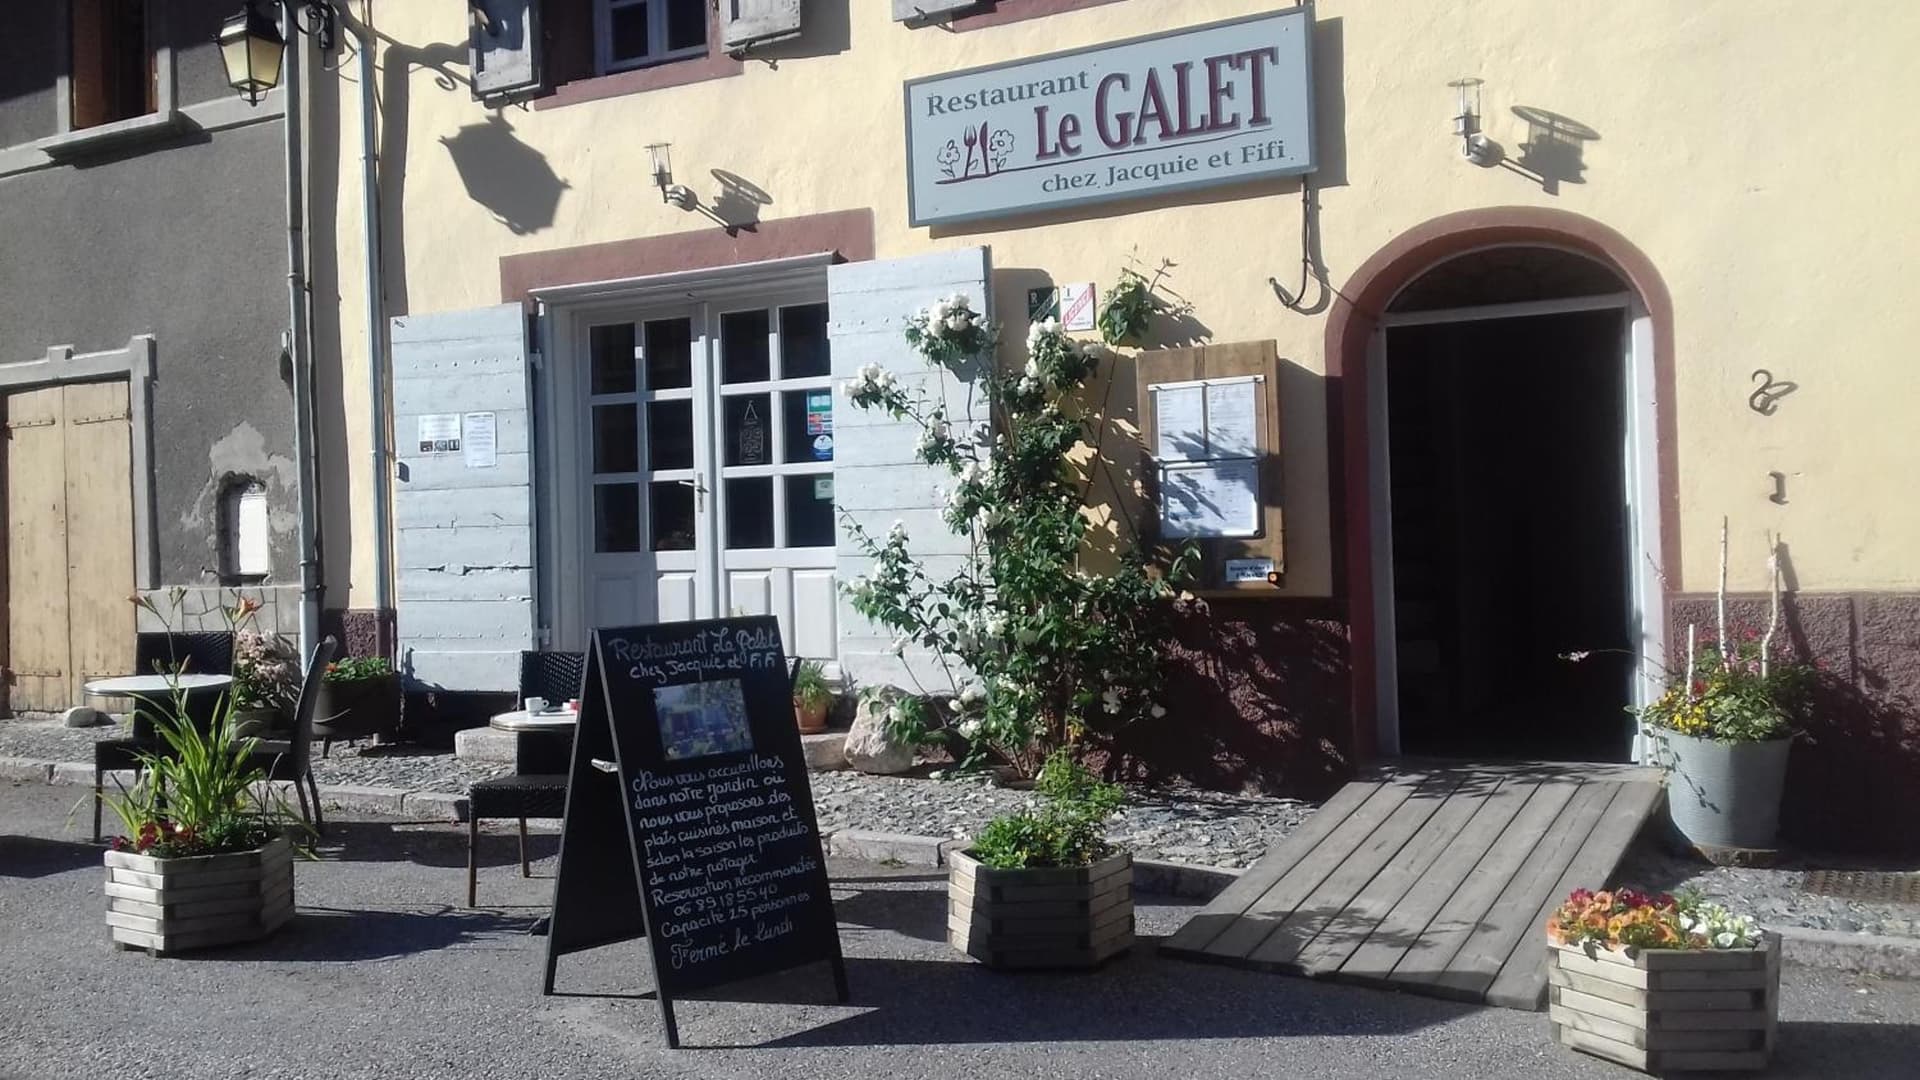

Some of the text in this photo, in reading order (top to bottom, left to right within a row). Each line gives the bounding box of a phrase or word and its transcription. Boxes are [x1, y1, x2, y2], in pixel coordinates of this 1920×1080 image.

[927, 70, 1089, 116] Restaurant
[1034, 46, 1279, 161] Le GALET
[1042, 139, 1285, 193] chez Jacquie et Fifi
[608, 630, 708, 661] Restaurant
[630, 661, 667, 685] chez
[666, 655, 725, 682] Jacquie
[727, 653, 743, 669] et
[632, 753, 784, 793] Nous vous accueillons
[635, 791, 667, 810] dans
[670, 787, 703, 803] notre
[707, 776, 758, 803] jardin
[639, 789, 792, 830] nous vous proposons des
[643, 831, 676, 857] plats
[732, 814, 780, 833] maison
[782, 804, 798, 821] et
[646, 823, 809, 868] selon la saison les produits
[649, 854, 758, 886] de notre potager
[674, 899, 692, 917] 06
[729, 902, 749, 921] 25
[751, 891, 810, 920] personnes
[734, 927, 751, 951] le
